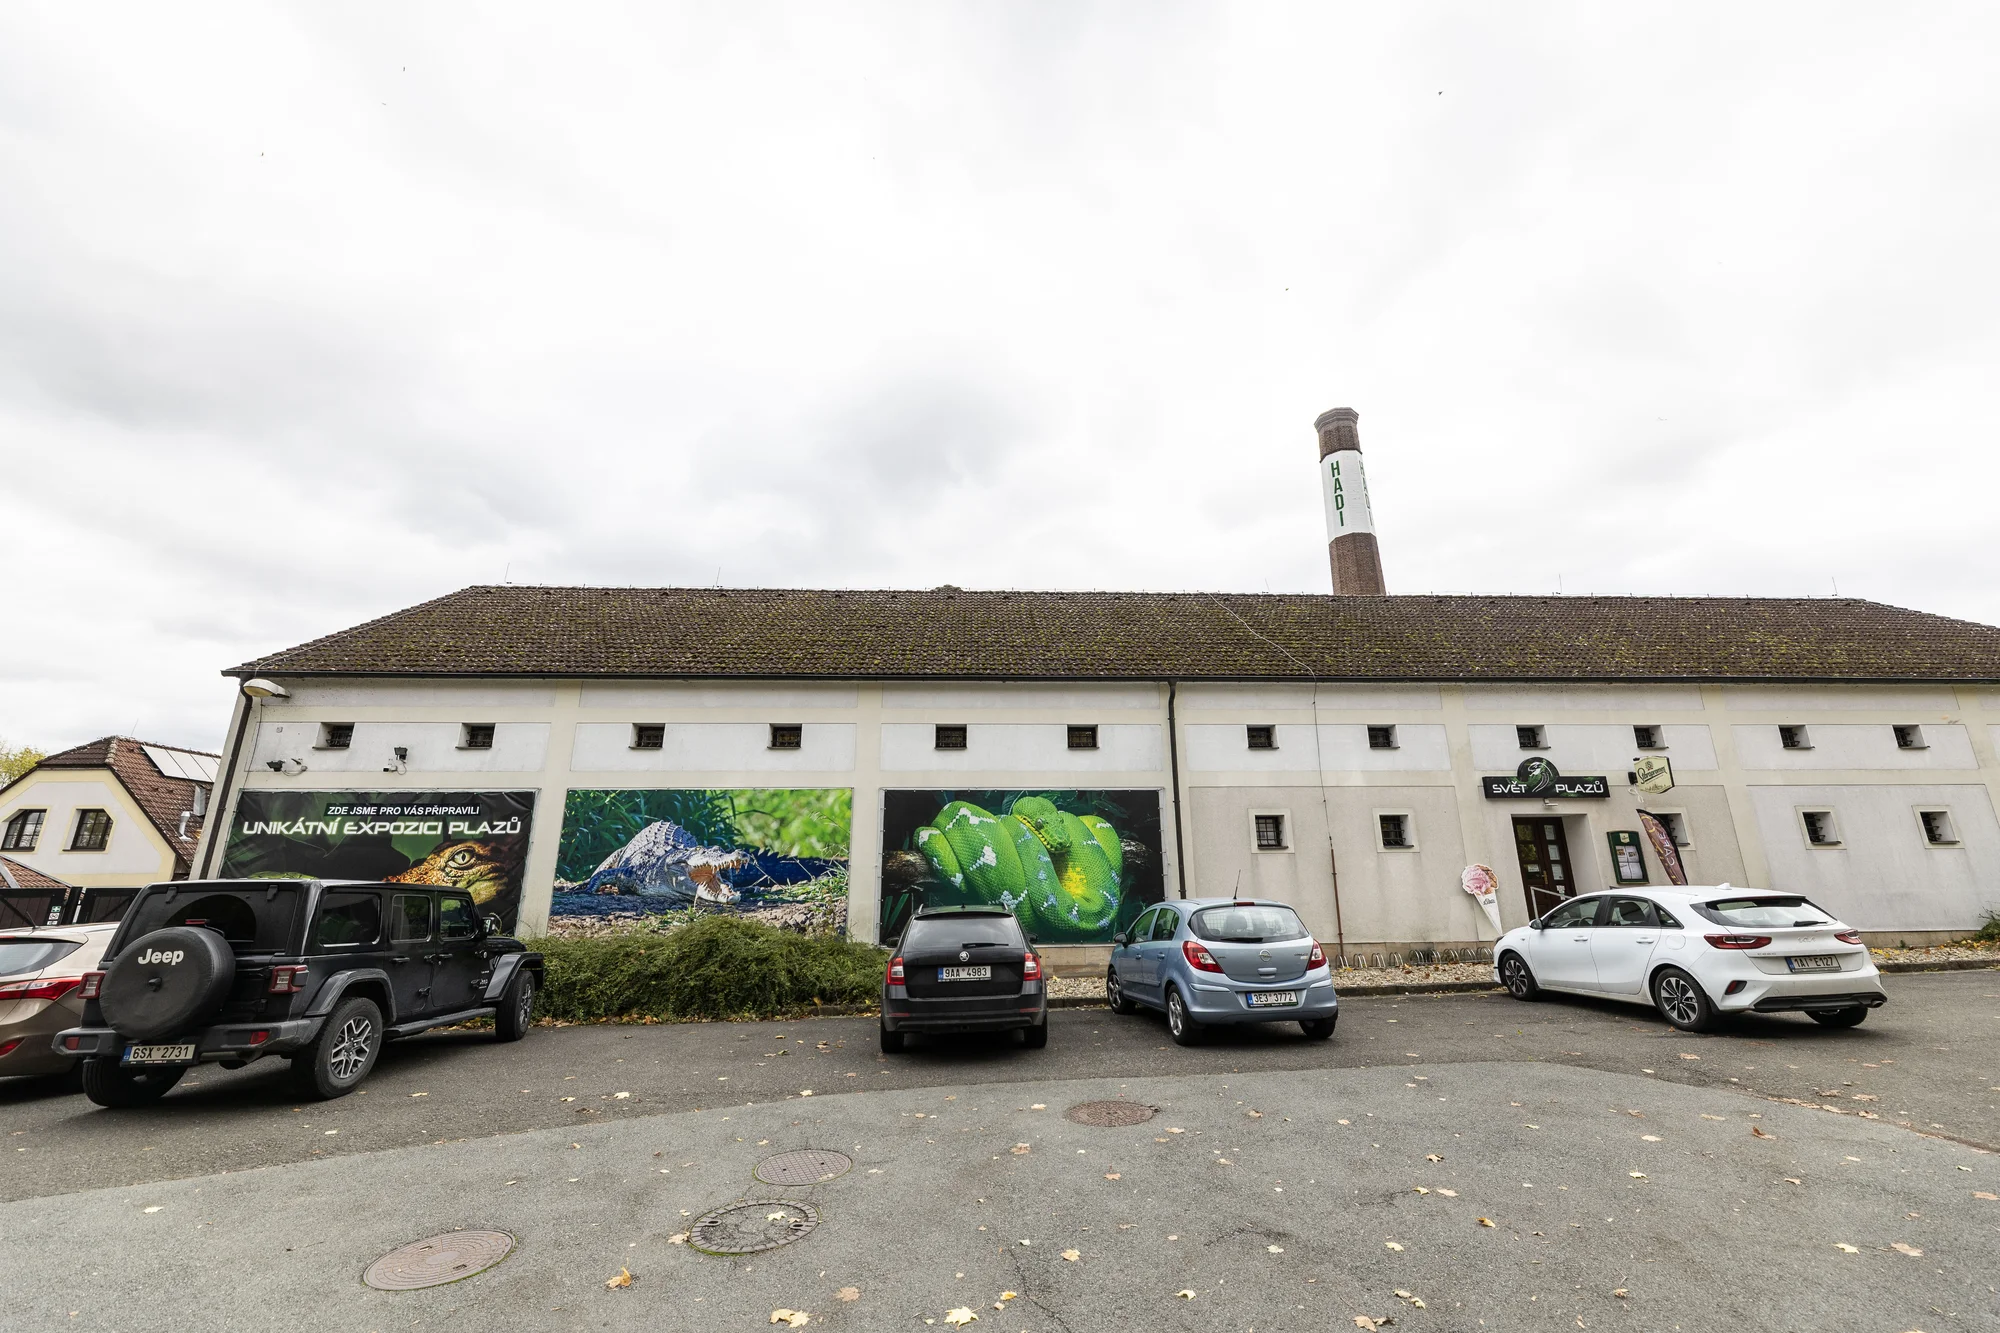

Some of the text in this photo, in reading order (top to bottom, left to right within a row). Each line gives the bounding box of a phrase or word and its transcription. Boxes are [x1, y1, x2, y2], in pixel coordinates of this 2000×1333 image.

[1331, 460, 1344, 527] HADI
[1492, 780, 1604, 794] SVĚT PLAZŮ
[327, 804, 480, 815] ZDE JSME PRO VÁS PŘIPRAVILI
[243, 816, 522, 835] UNIKÁTNÍ EXPOZICI PLAZŮ
[137, 948, 184, 966] Jeep
[944, 967, 988, 978] 9AA 4983
[1254, 992, 1294, 1003] 3E3 3772
[132, 1046, 189, 1060] 6SX 2731
